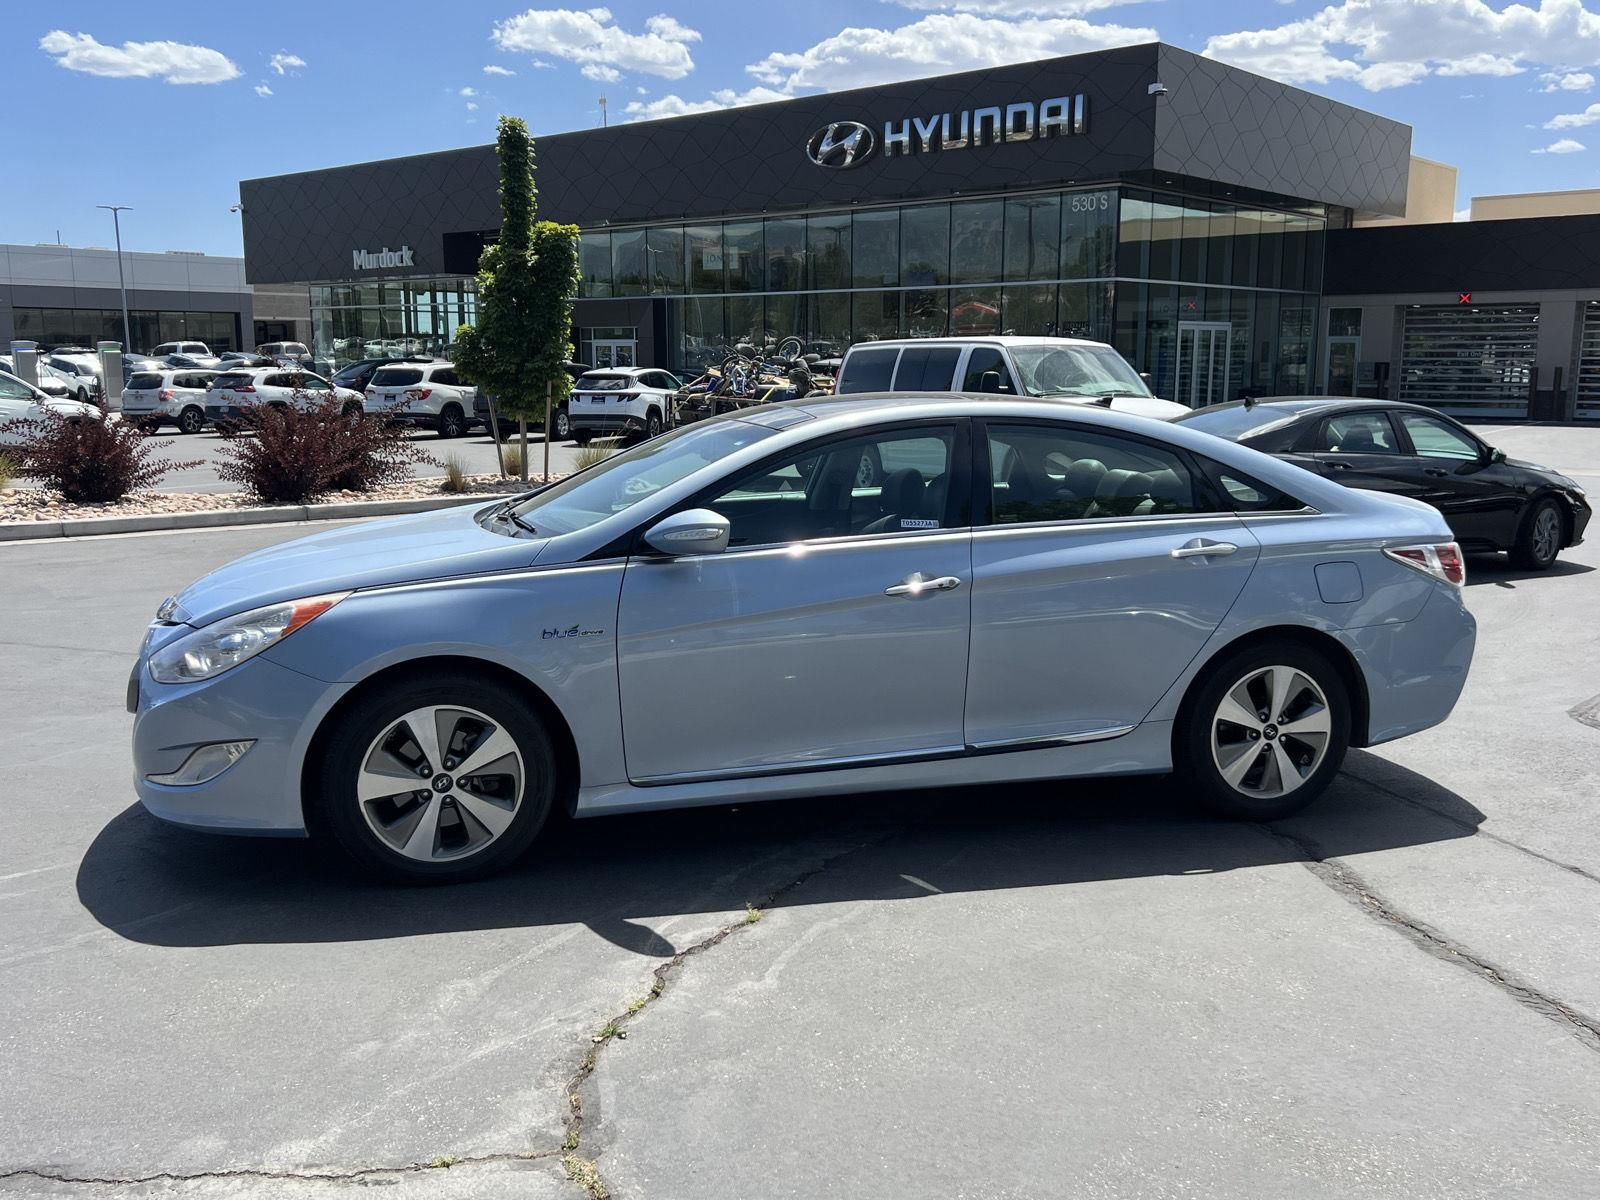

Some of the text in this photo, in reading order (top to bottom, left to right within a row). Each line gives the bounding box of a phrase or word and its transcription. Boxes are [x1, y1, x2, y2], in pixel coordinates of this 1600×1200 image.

[884, 93, 1086, 157] HYUNDAI
[1071, 194, 1108, 212] 530 S
[352, 245, 414, 270] Murdock
[542, 626, 579, 639] blue
